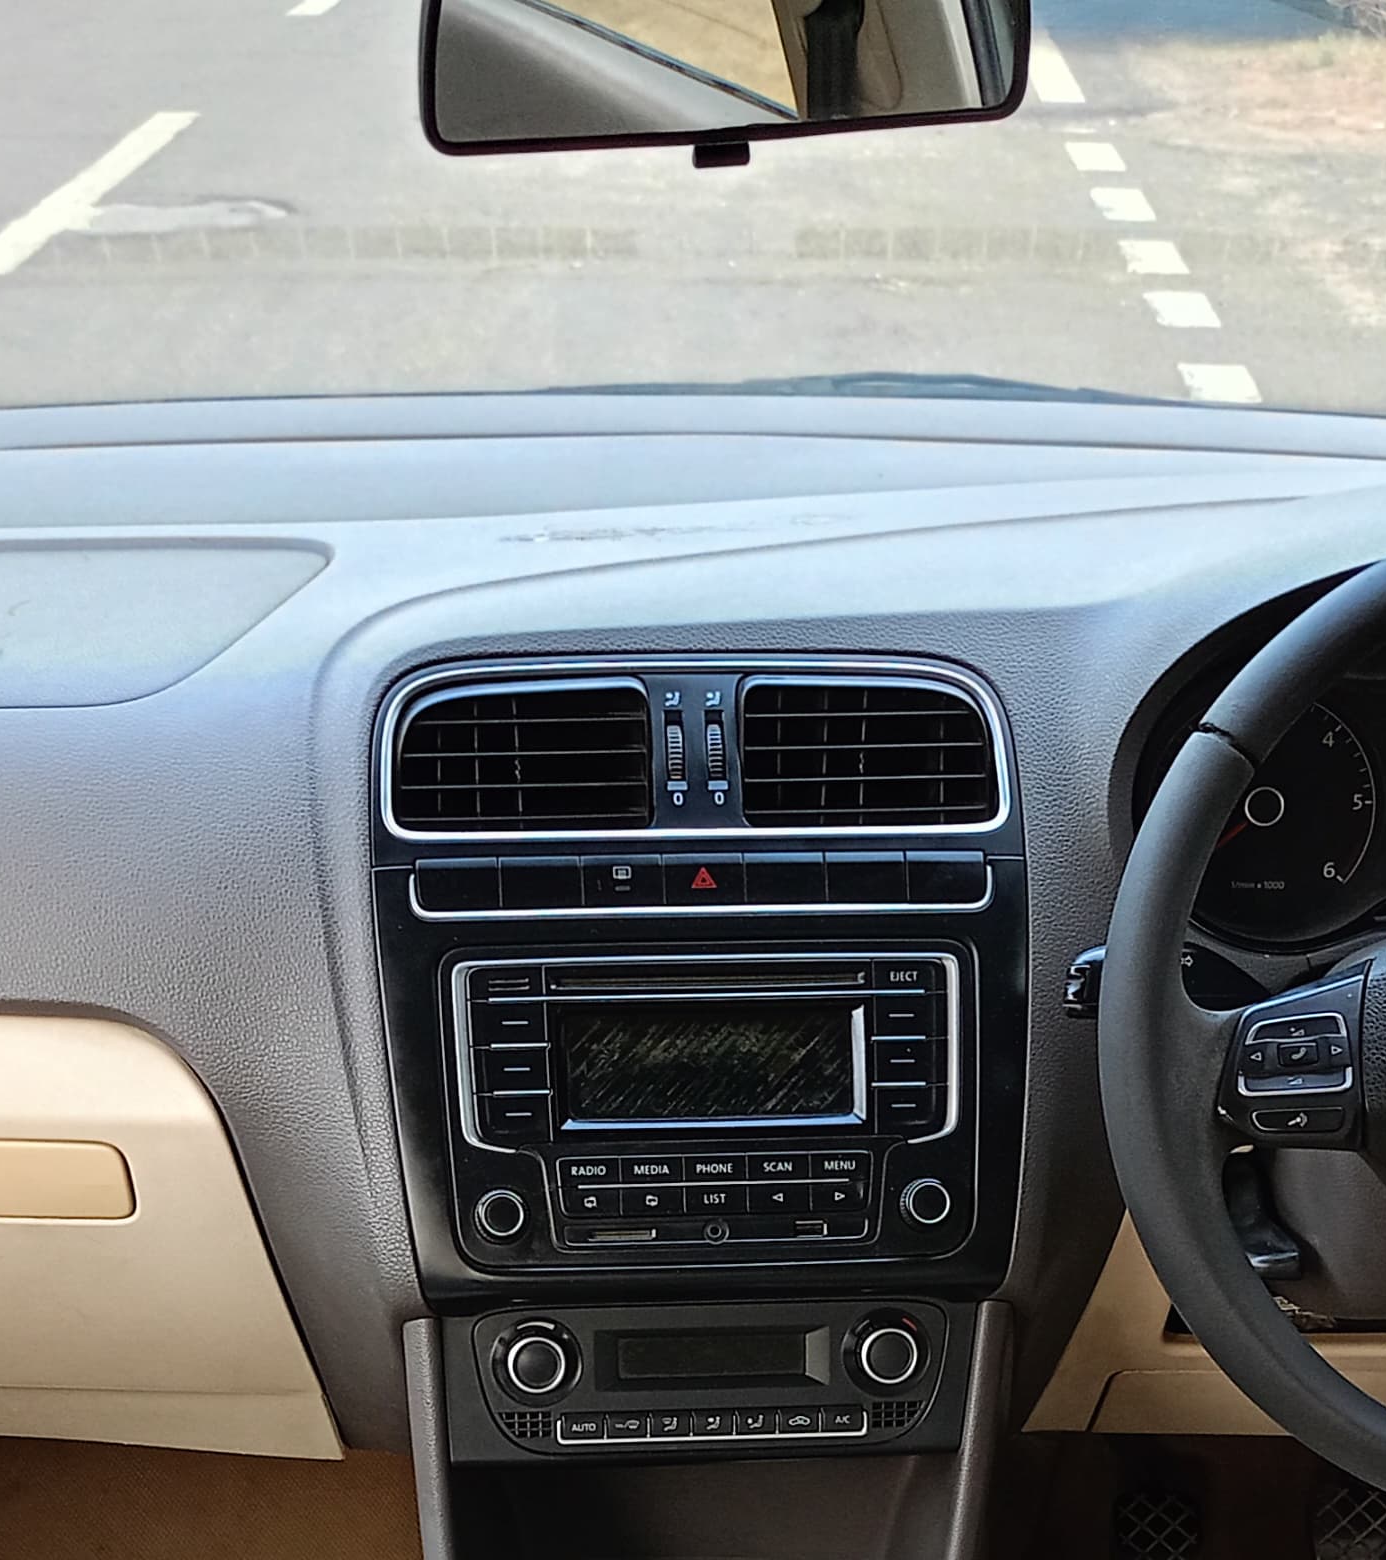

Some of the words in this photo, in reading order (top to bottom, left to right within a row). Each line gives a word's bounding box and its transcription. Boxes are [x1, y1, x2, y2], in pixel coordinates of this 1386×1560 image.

[1322, 731, 1336, 748] 4
[1352, 793, 1364, 810] 5
[1323, 861, 1336, 878] 6
[1263, 880, 1286, 889] 1000
[889, 970, 918, 982] EJECT
[570, 1165, 607, 1176] RADIO
[633, 1164, 670, 1175] MEDIA
[696, 1163, 734, 1174] PHONE
[763, 1161, 793, 1172] SCAN
[824, 1159, 856, 1171] MENU
[703, 1193, 726, 1204] LIST
[835, 1415, 851, 1425] A/C
[571, 1422, 597, 1433] AUTO
